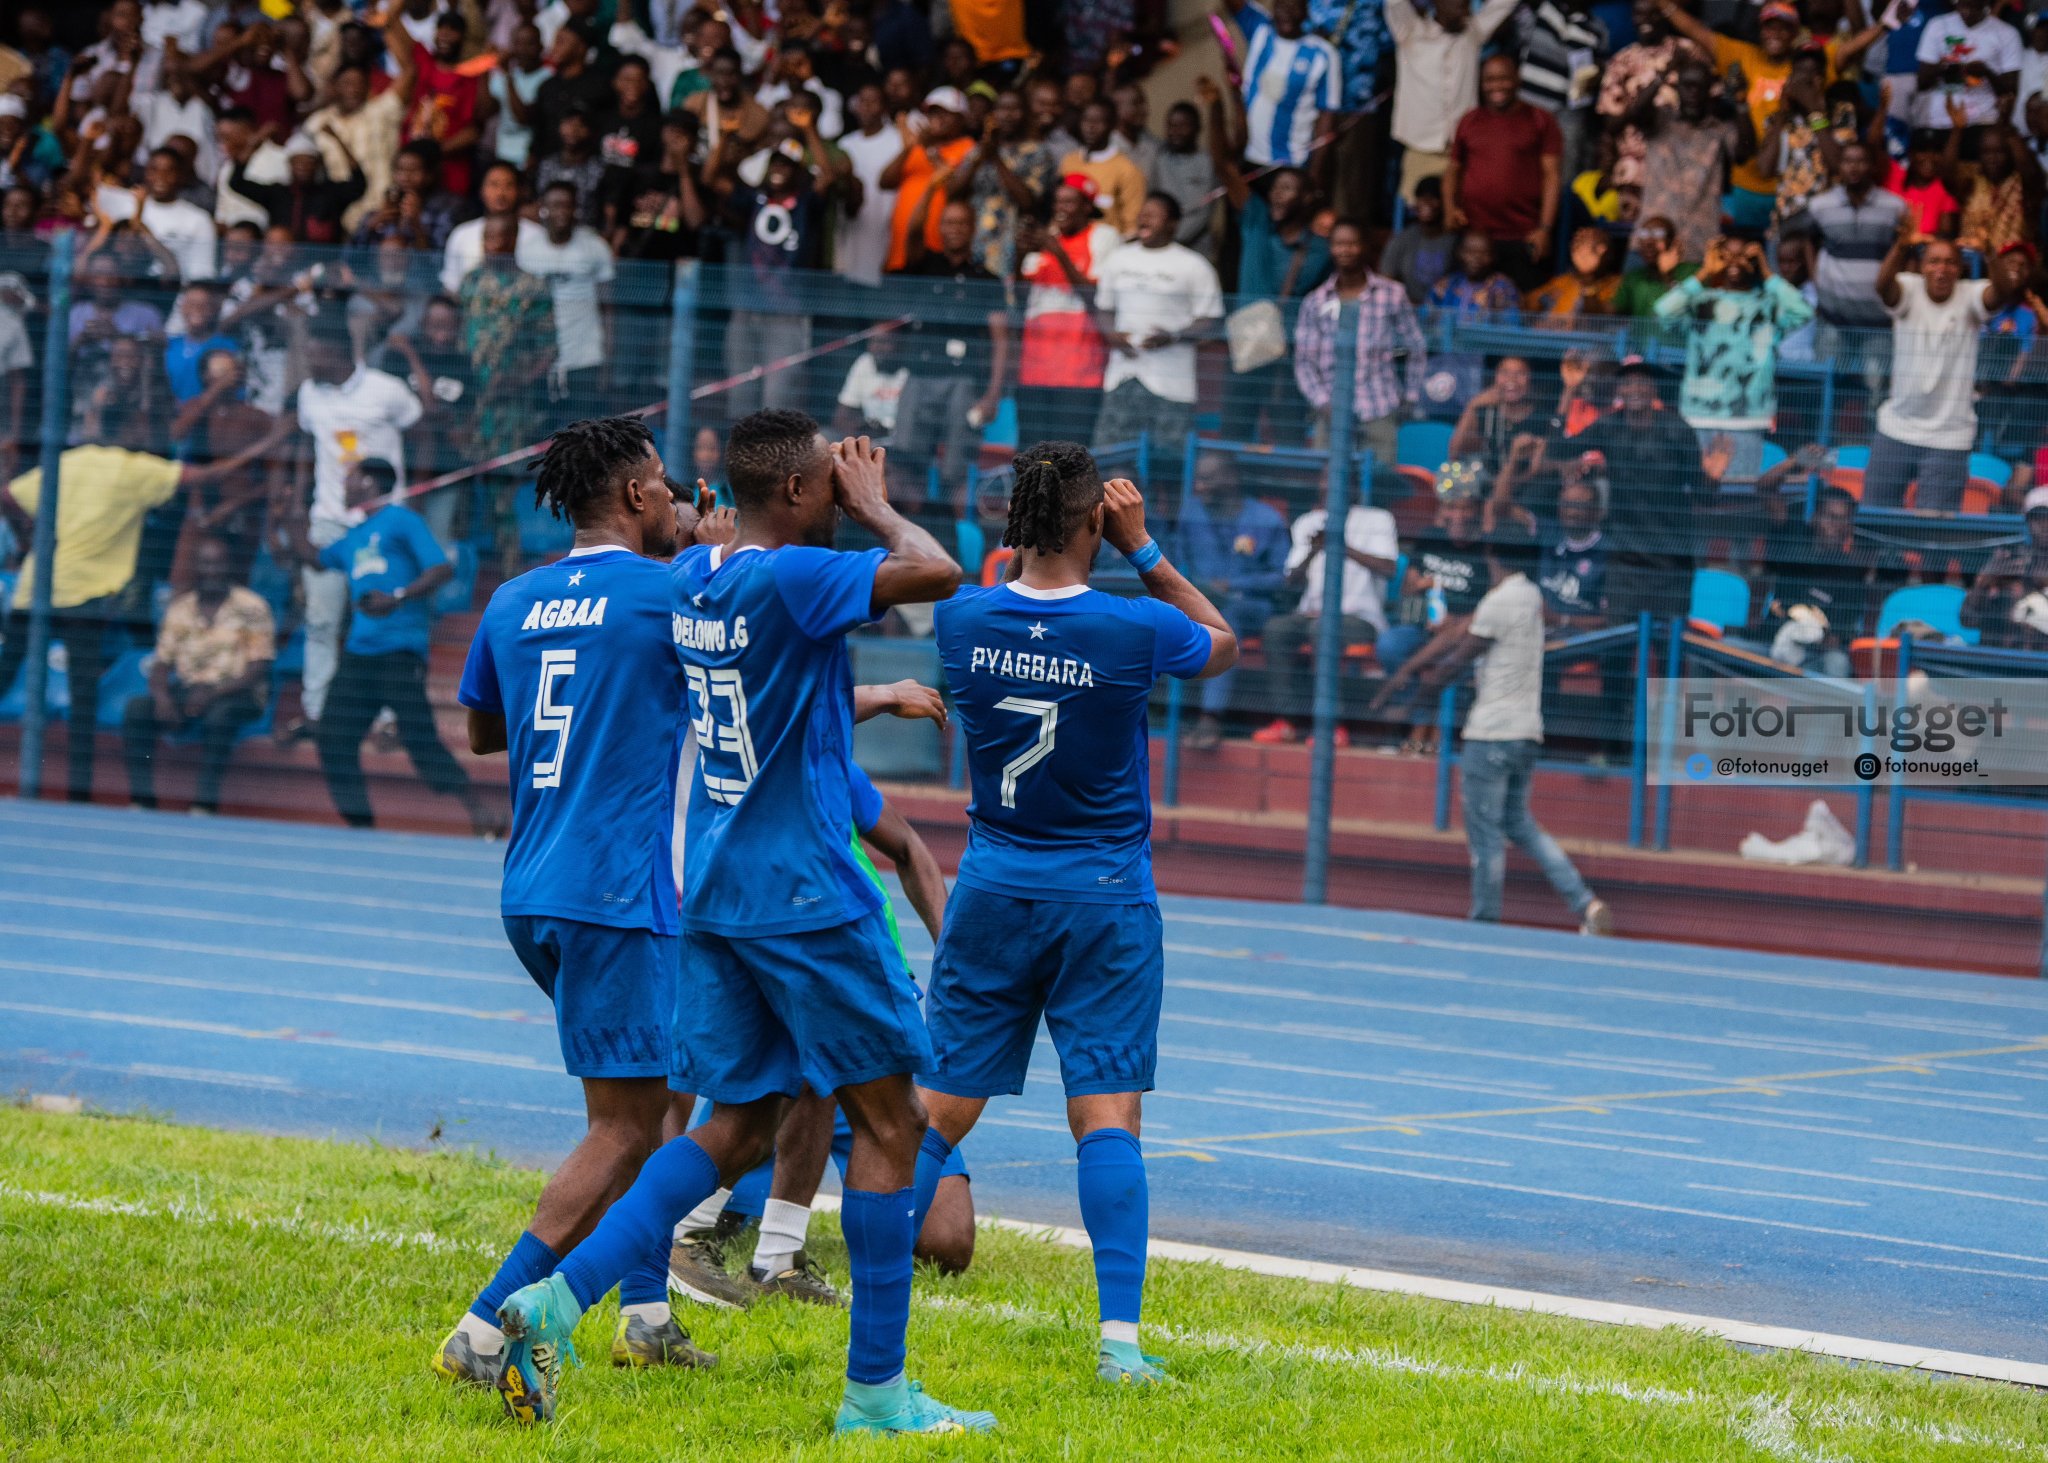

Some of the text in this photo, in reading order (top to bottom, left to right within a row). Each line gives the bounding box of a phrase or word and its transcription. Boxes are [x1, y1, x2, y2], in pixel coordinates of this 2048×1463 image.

[521, 597, 608, 630] AGBAA
[970, 646, 1094, 688] PYAGBARA
[532, 649, 576, 788] 5
[683, 663, 760, 807] 23
[992, 696, 1058, 809] 7
